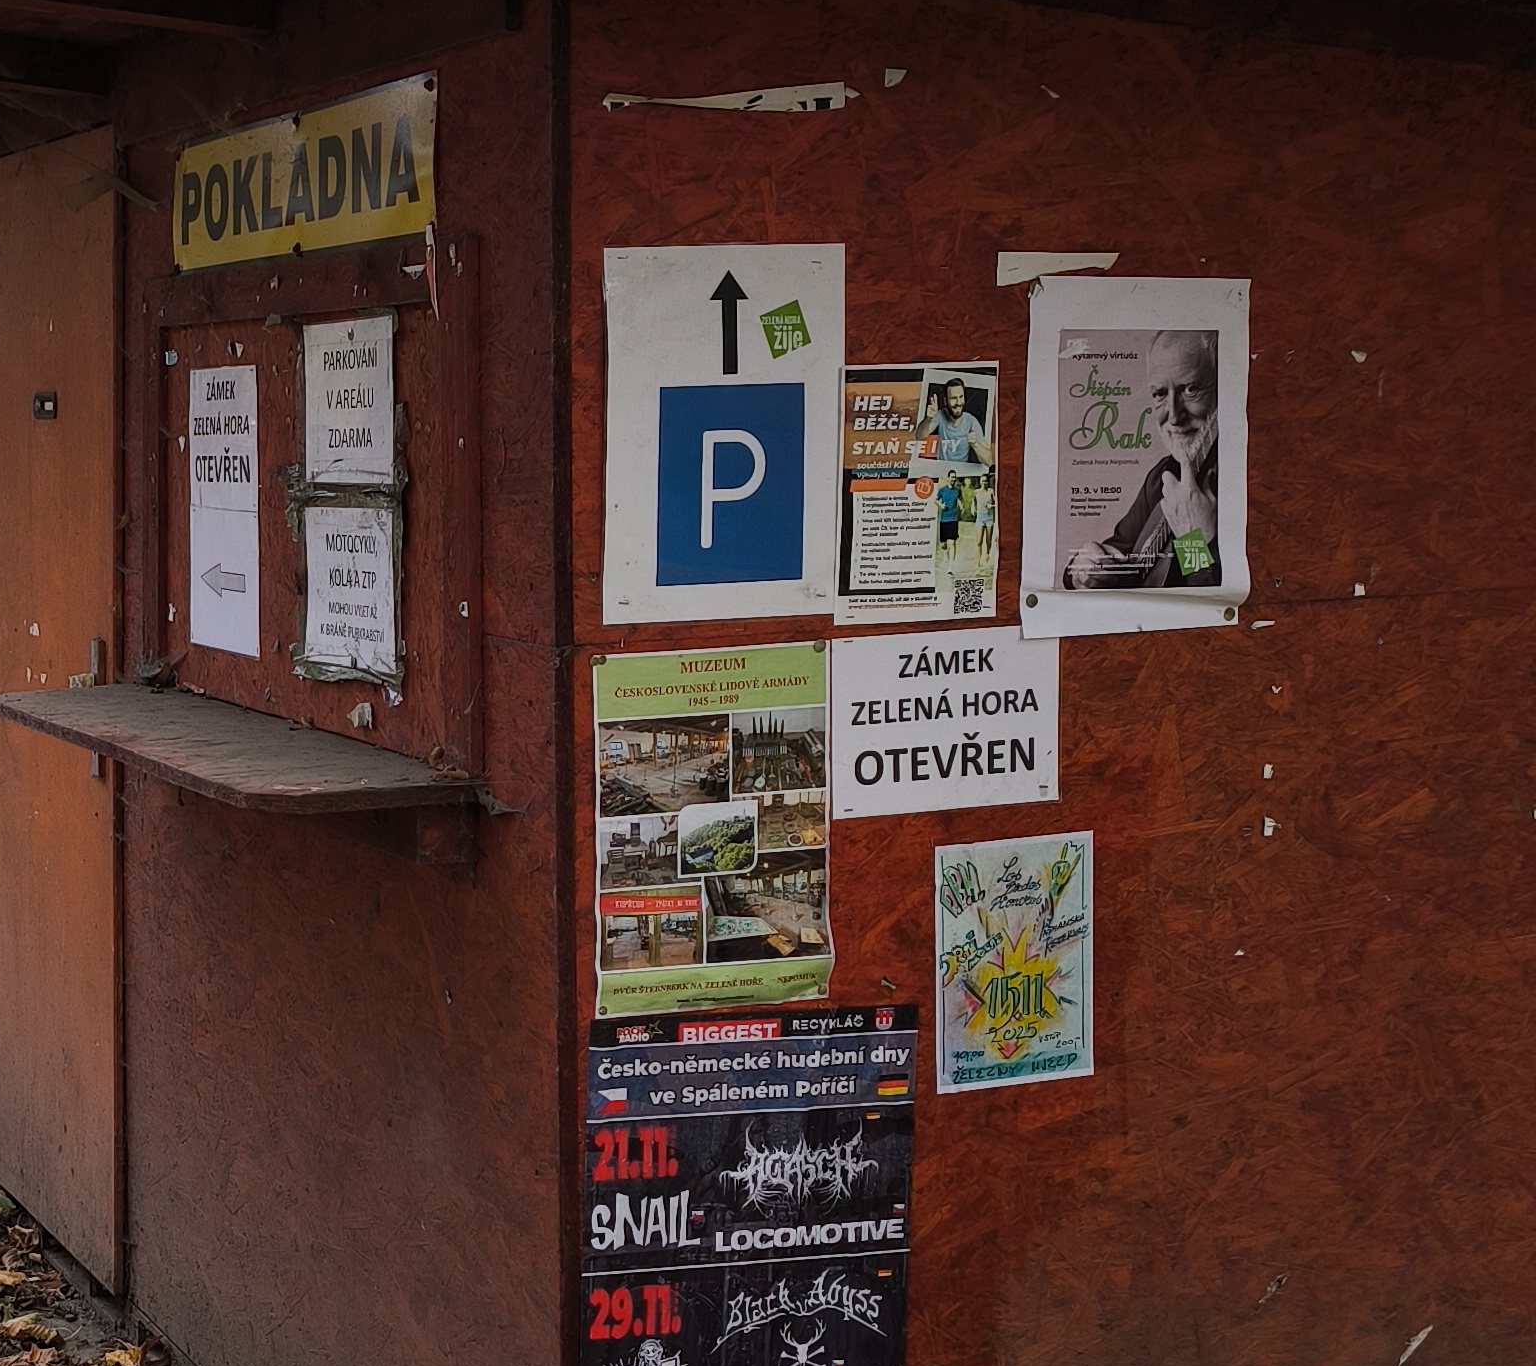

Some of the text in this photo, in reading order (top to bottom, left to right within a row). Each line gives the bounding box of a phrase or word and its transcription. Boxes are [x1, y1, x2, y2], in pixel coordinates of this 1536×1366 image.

[181, 116, 421, 246] POKLADNA
[774, 324, 804, 353] žije
[323, 340, 378, 371] PARKOVÁNÍ
[206, 376, 236, 401] ZÁMEK
[326, 382, 374, 410] V AREÁLU
[1069, 364, 1132, 401] Štěpán
[853, 396, 893, 412] HEJ
[193, 410, 250, 436] ZELENÁ HORA
[853, 413, 915, 432] BĚŽČE,
[1069, 400, 1152, 450] Rak
[328, 427, 373, 449] ZDARMA
[852, 437, 900, 455] STAŇ
[904, 440, 927, 455] SE
[941, 439, 962, 454] TY
[195, 447, 251, 483] OTEVŘEN
[700, 429, 767, 549] P
[1184, 547, 1210, 573] žije
[362, 571, 377, 589] ZTP
[680, 657, 747, 674] MUZEUM
[898, 645, 995, 679] ZÁMEK
[614, 675, 810, 698] ČESKOSLOVENSKÉ LIDOVÉ ARMÁDY
[688, 696, 709, 707] 1945
[719, 694, 740, 705] 1989
[851, 687, 1039, 726] ZELENÁ HORA
[854, 731, 1035, 786] OTEVŘEN
[682, 1022, 778, 1043] BIGGEST
[597, 1045, 910, 1080] Česko-německé hudební dny
[649, 1075, 856, 1107] ve Spáleném Poříčí
[592, 1126, 679, 1182] 21.11.
[715, 1218, 905, 1252] LOCOMOTIVE
[589, 1285, 682, 1340] 29.11.
